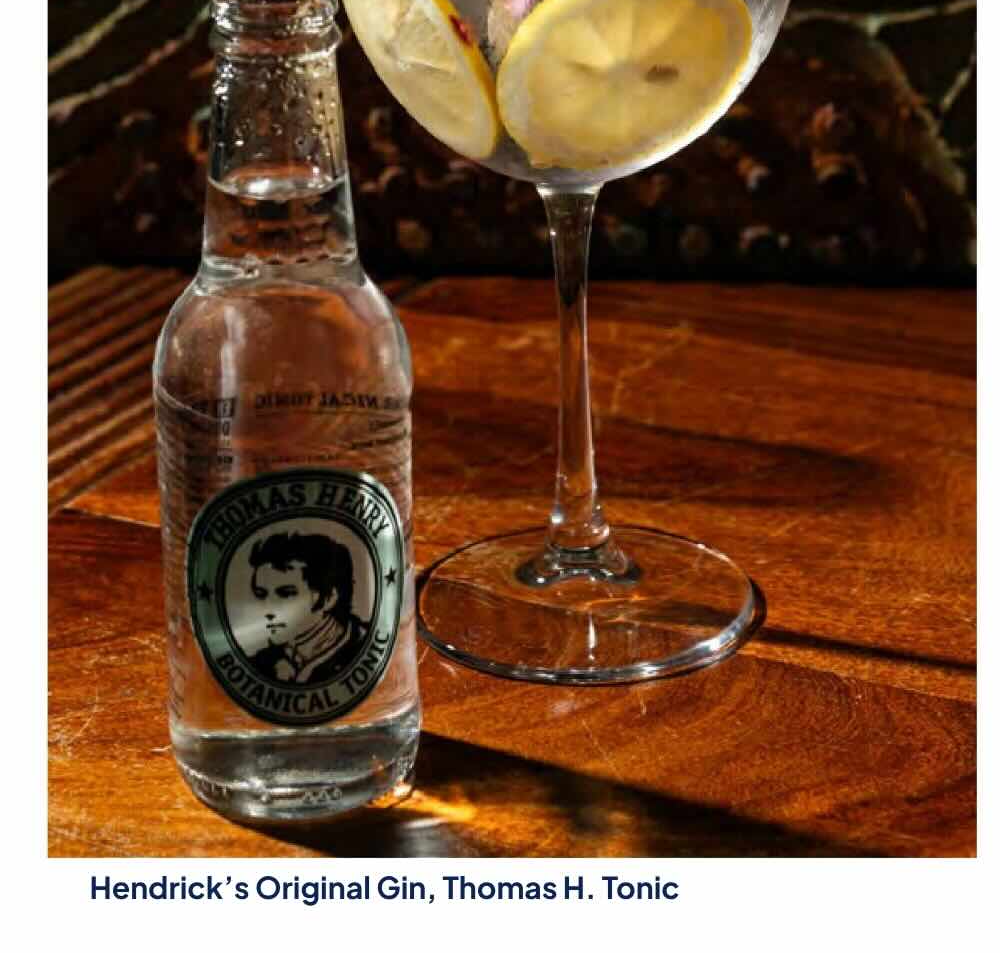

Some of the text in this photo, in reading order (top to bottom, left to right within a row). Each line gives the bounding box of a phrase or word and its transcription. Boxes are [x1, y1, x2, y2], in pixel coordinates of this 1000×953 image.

[205, 483, 389, 547] THOMAS HENRY
[215, 631, 390, 713] BOTANICAL TONIC
